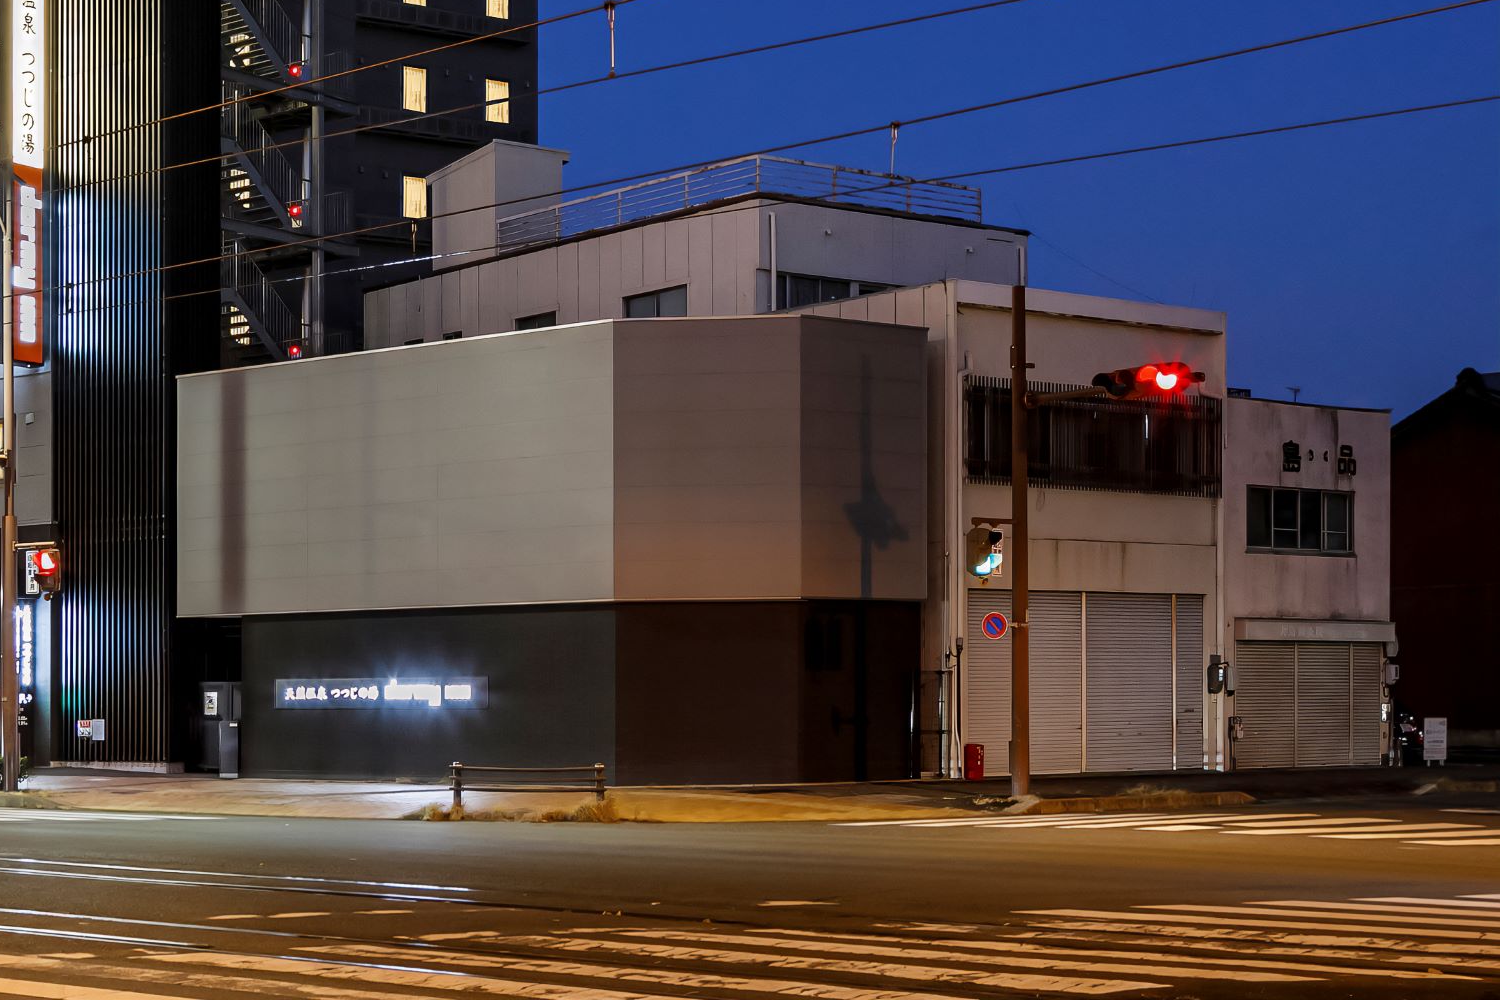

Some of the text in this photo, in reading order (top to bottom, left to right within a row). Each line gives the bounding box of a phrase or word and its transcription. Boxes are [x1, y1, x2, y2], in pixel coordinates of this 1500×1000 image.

[22, 52, 35, 154] つつじの湯
